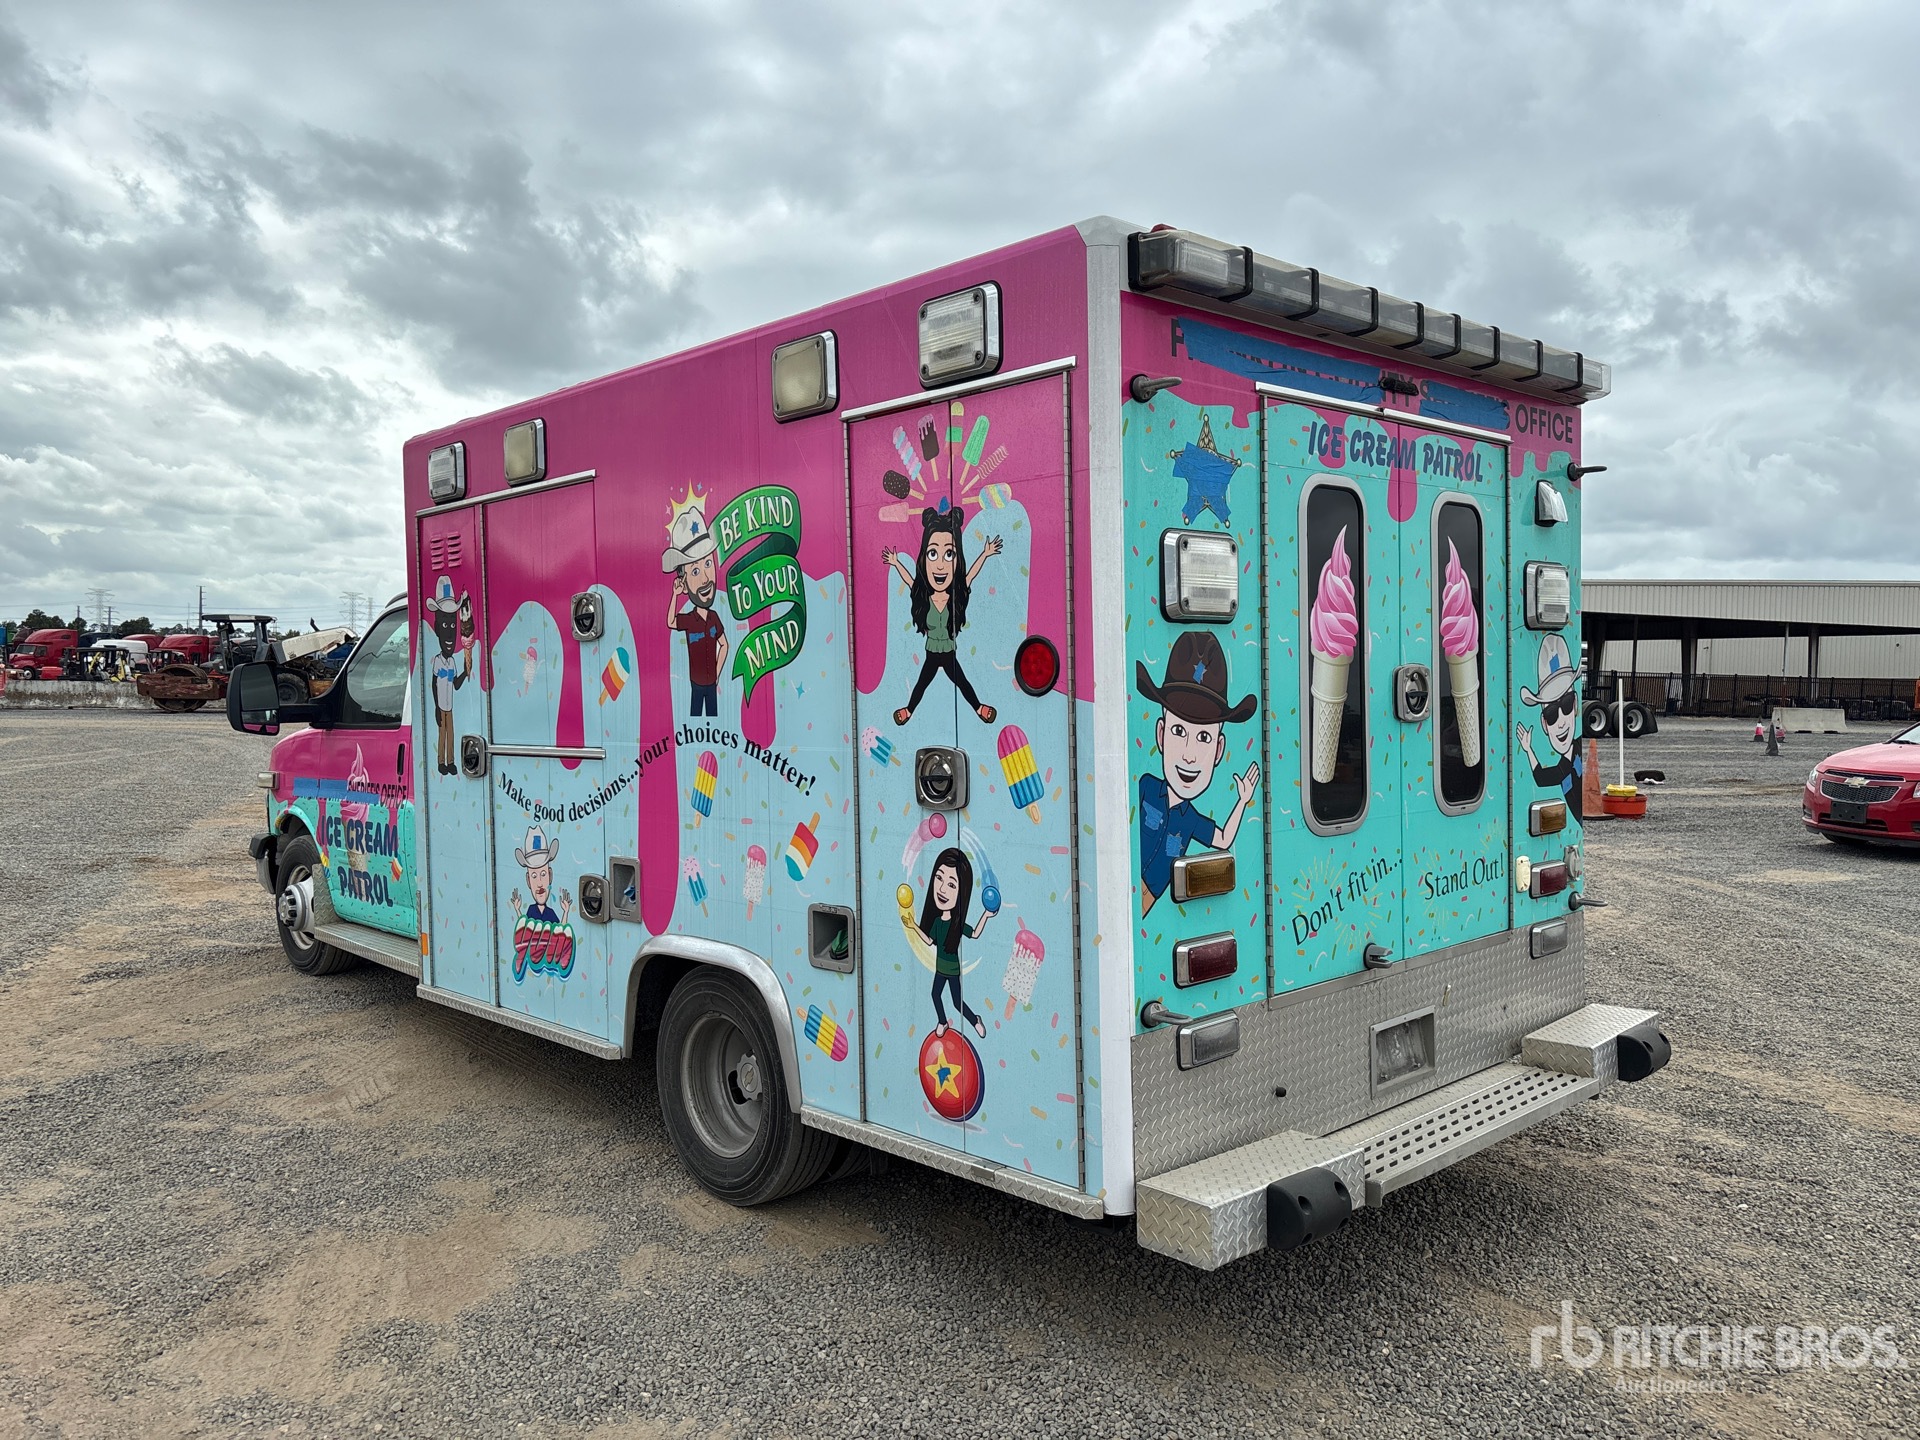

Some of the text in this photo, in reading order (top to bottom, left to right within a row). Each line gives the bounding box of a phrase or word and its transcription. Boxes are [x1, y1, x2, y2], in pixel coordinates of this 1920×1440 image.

[1514, 403, 1573, 444] OFFICE
[1308, 421, 1483, 482] ICE CREAM PATROL
[719, 495, 794, 552] BE KIND
[752, 564, 799, 603] YOUR
[743, 619, 799, 678] MIND
[498, 771, 532, 812] Make
[533, 804, 565, 823] good
[675, 721, 739, 749] choices
[743, 738, 816, 797] matter!
[320, 815, 399, 858] ICE CREAM
[337, 865, 394, 907] PATROL
[1424, 853, 1505, 901] Stand Out!
[1291, 888, 1345, 946] Don't
[1347, 871, 1369, 902] fit
